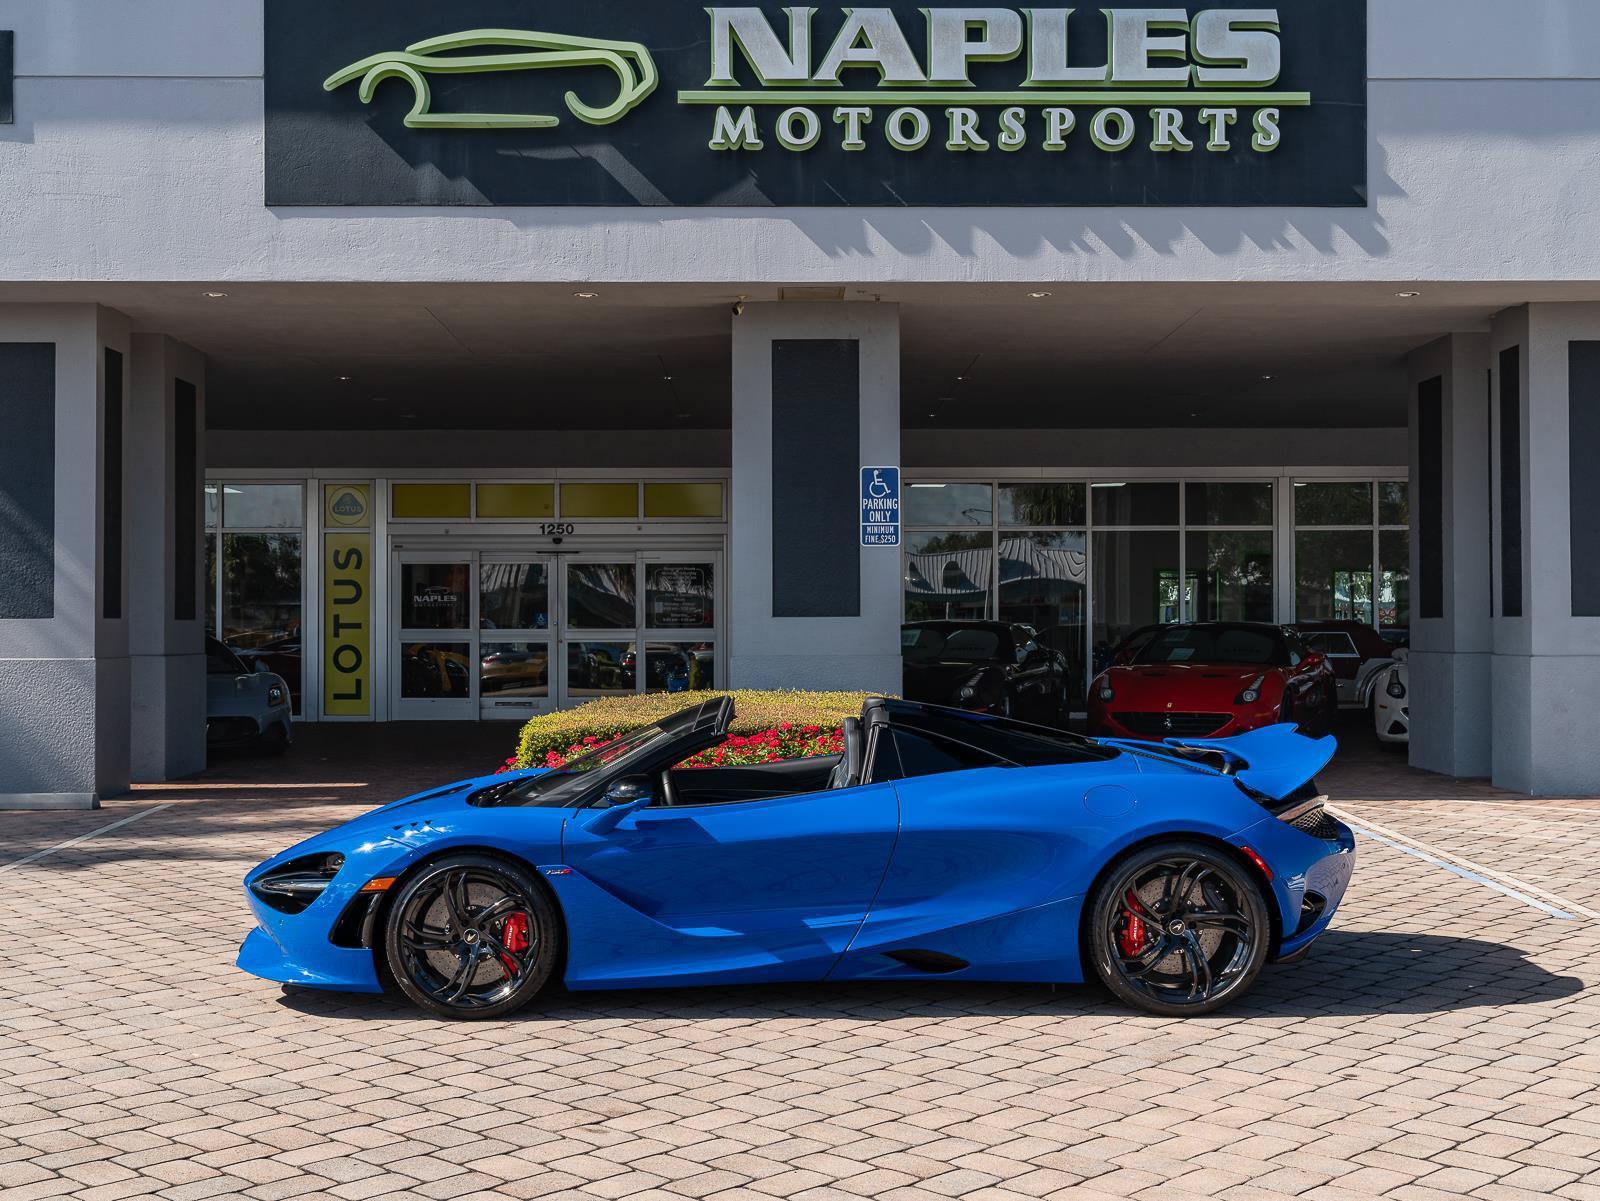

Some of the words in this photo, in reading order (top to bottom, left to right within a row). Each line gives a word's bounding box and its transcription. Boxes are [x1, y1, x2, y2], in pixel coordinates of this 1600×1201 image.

[703, 7, 1281, 88] NAPLES
[708, 106, 1281, 152] MOTORSPORTS
[334, 505, 362, 513] LOTUS
[862, 498, 898, 510] PARKING
[869, 511, 891, 522] ONLY
[540, 523, 575, 535] 1250
[866, 526, 895, 534] MINIMUM
[865, 535, 880, 543] FINE
[880, 535, 896, 543] $250
[333, 547, 363, 700] LOTUS
